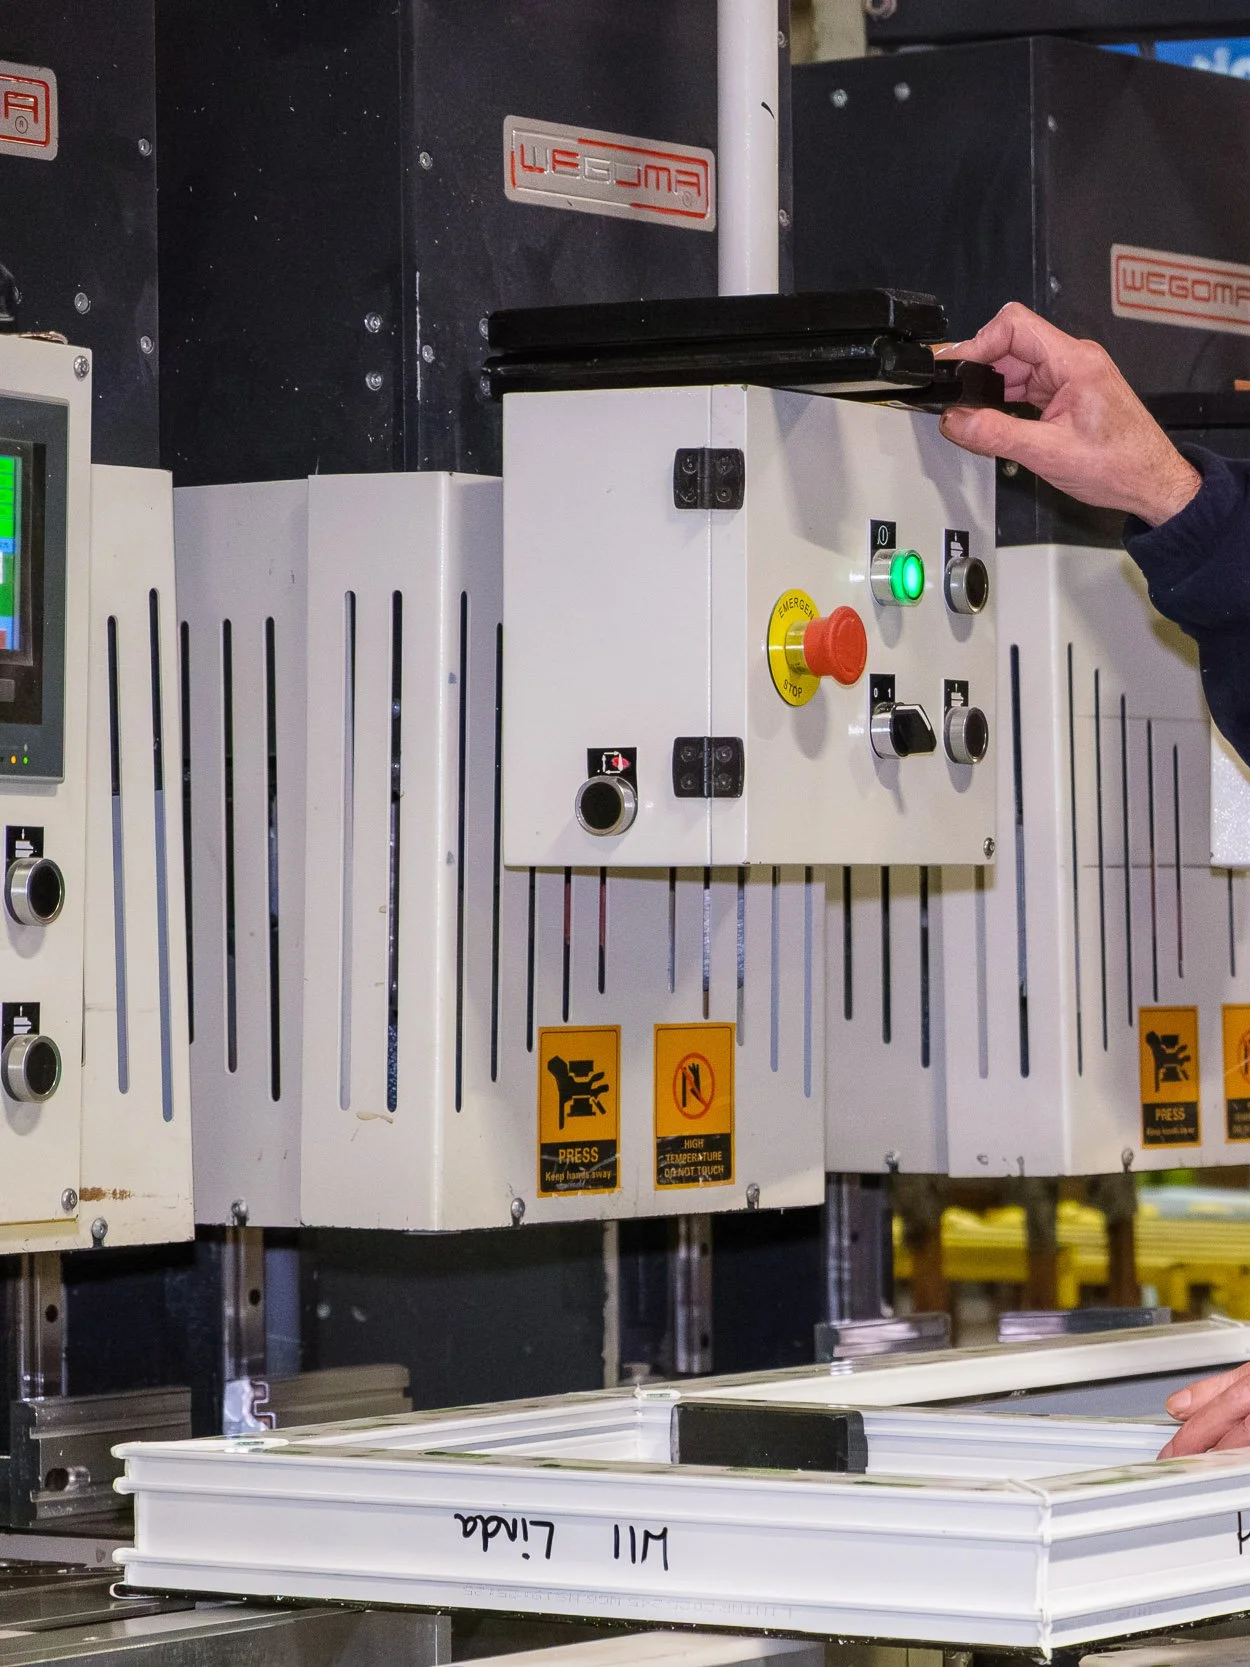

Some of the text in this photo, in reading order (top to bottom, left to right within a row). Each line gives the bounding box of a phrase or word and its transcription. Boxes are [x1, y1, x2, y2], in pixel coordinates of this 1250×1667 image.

[519, 143, 701, 197] WEGOMA
[778, 597, 815, 621] EMERGEN
[783, 679, 803, 699] STOP
[1155, 1107, 1186, 1121] PRESS
[684, 1138, 705, 1150] HIGH
[558, 1146, 599, 1164] PRESS
[664, 1151, 723, 1164] TEMPERATURE
[545, 1171, 565, 1183] Keep
[677, 1166, 695, 1177] NOT
[696, 1164, 725, 1175] TOUCH
[453, 1512, 555, 1560] Linda
